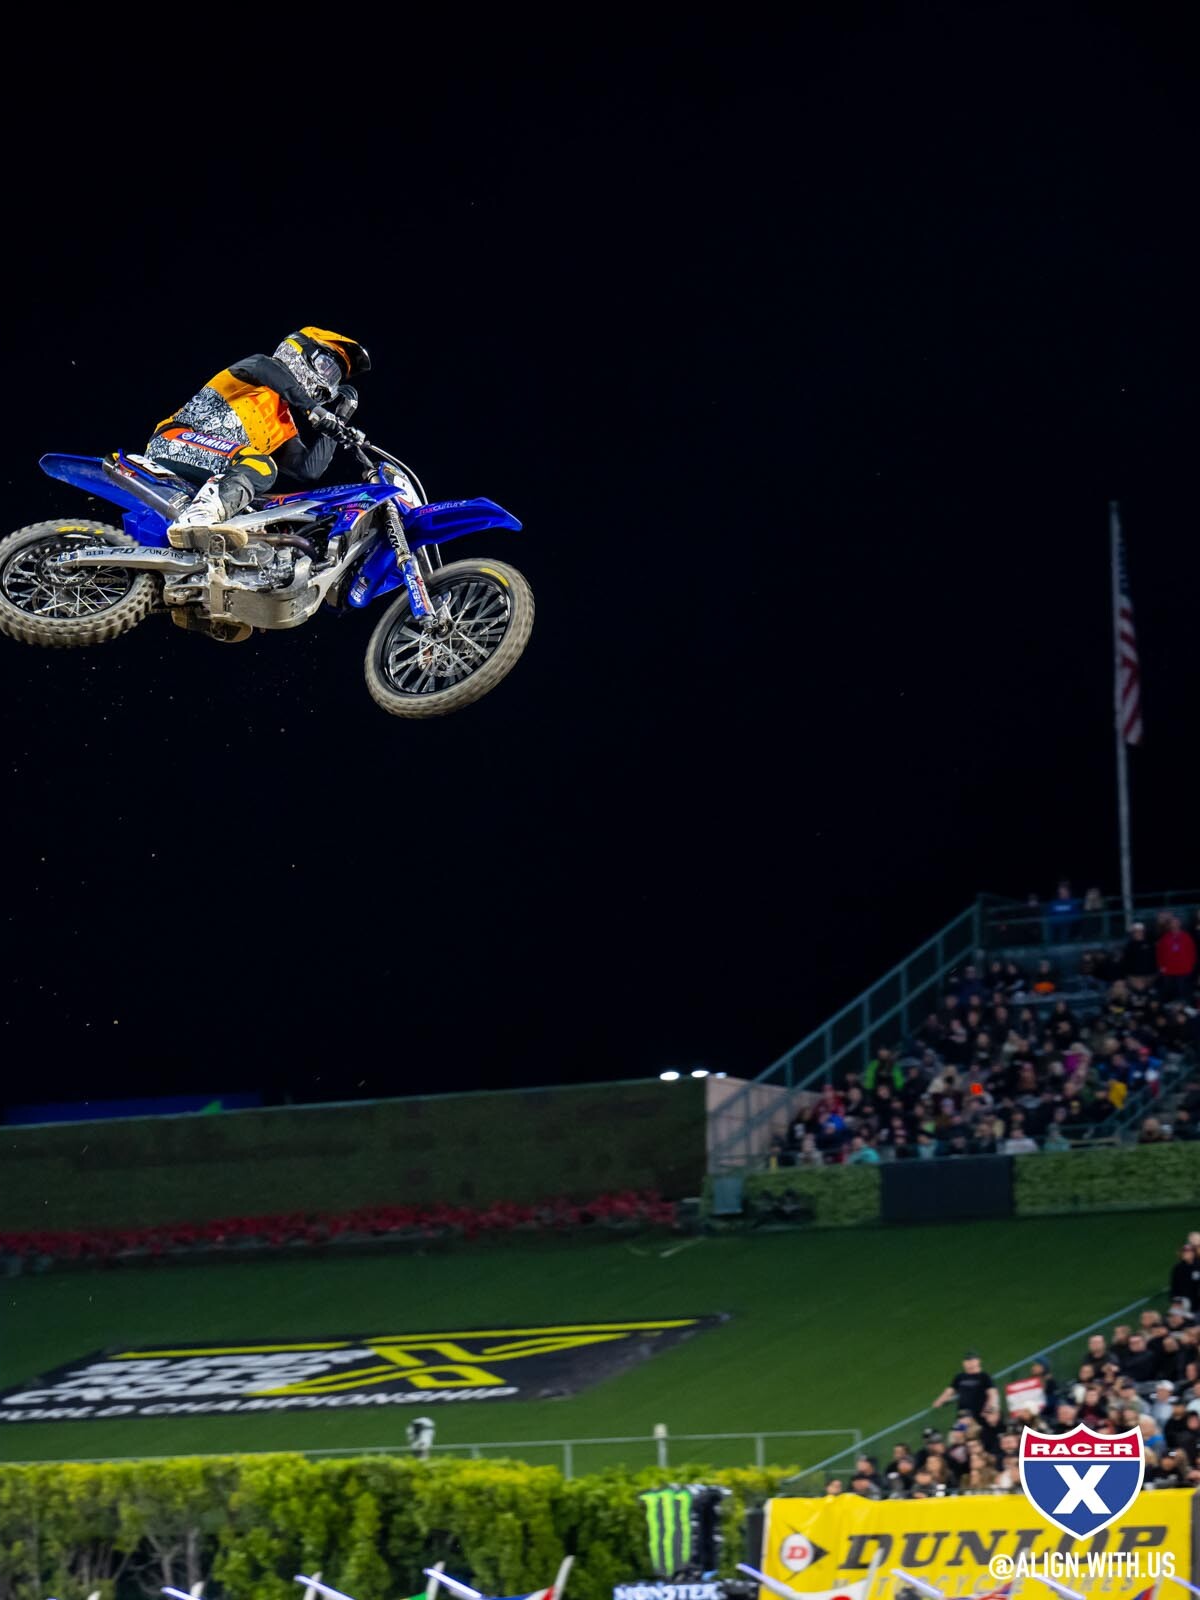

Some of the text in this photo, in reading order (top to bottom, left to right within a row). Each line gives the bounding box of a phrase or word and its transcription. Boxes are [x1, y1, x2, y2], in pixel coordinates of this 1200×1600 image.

[193, 434, 234, 452] YAMAHA
[139, 1387, 519, 1415] CHAMPIONSHIP
[787, 1546, 808, 1560] D
